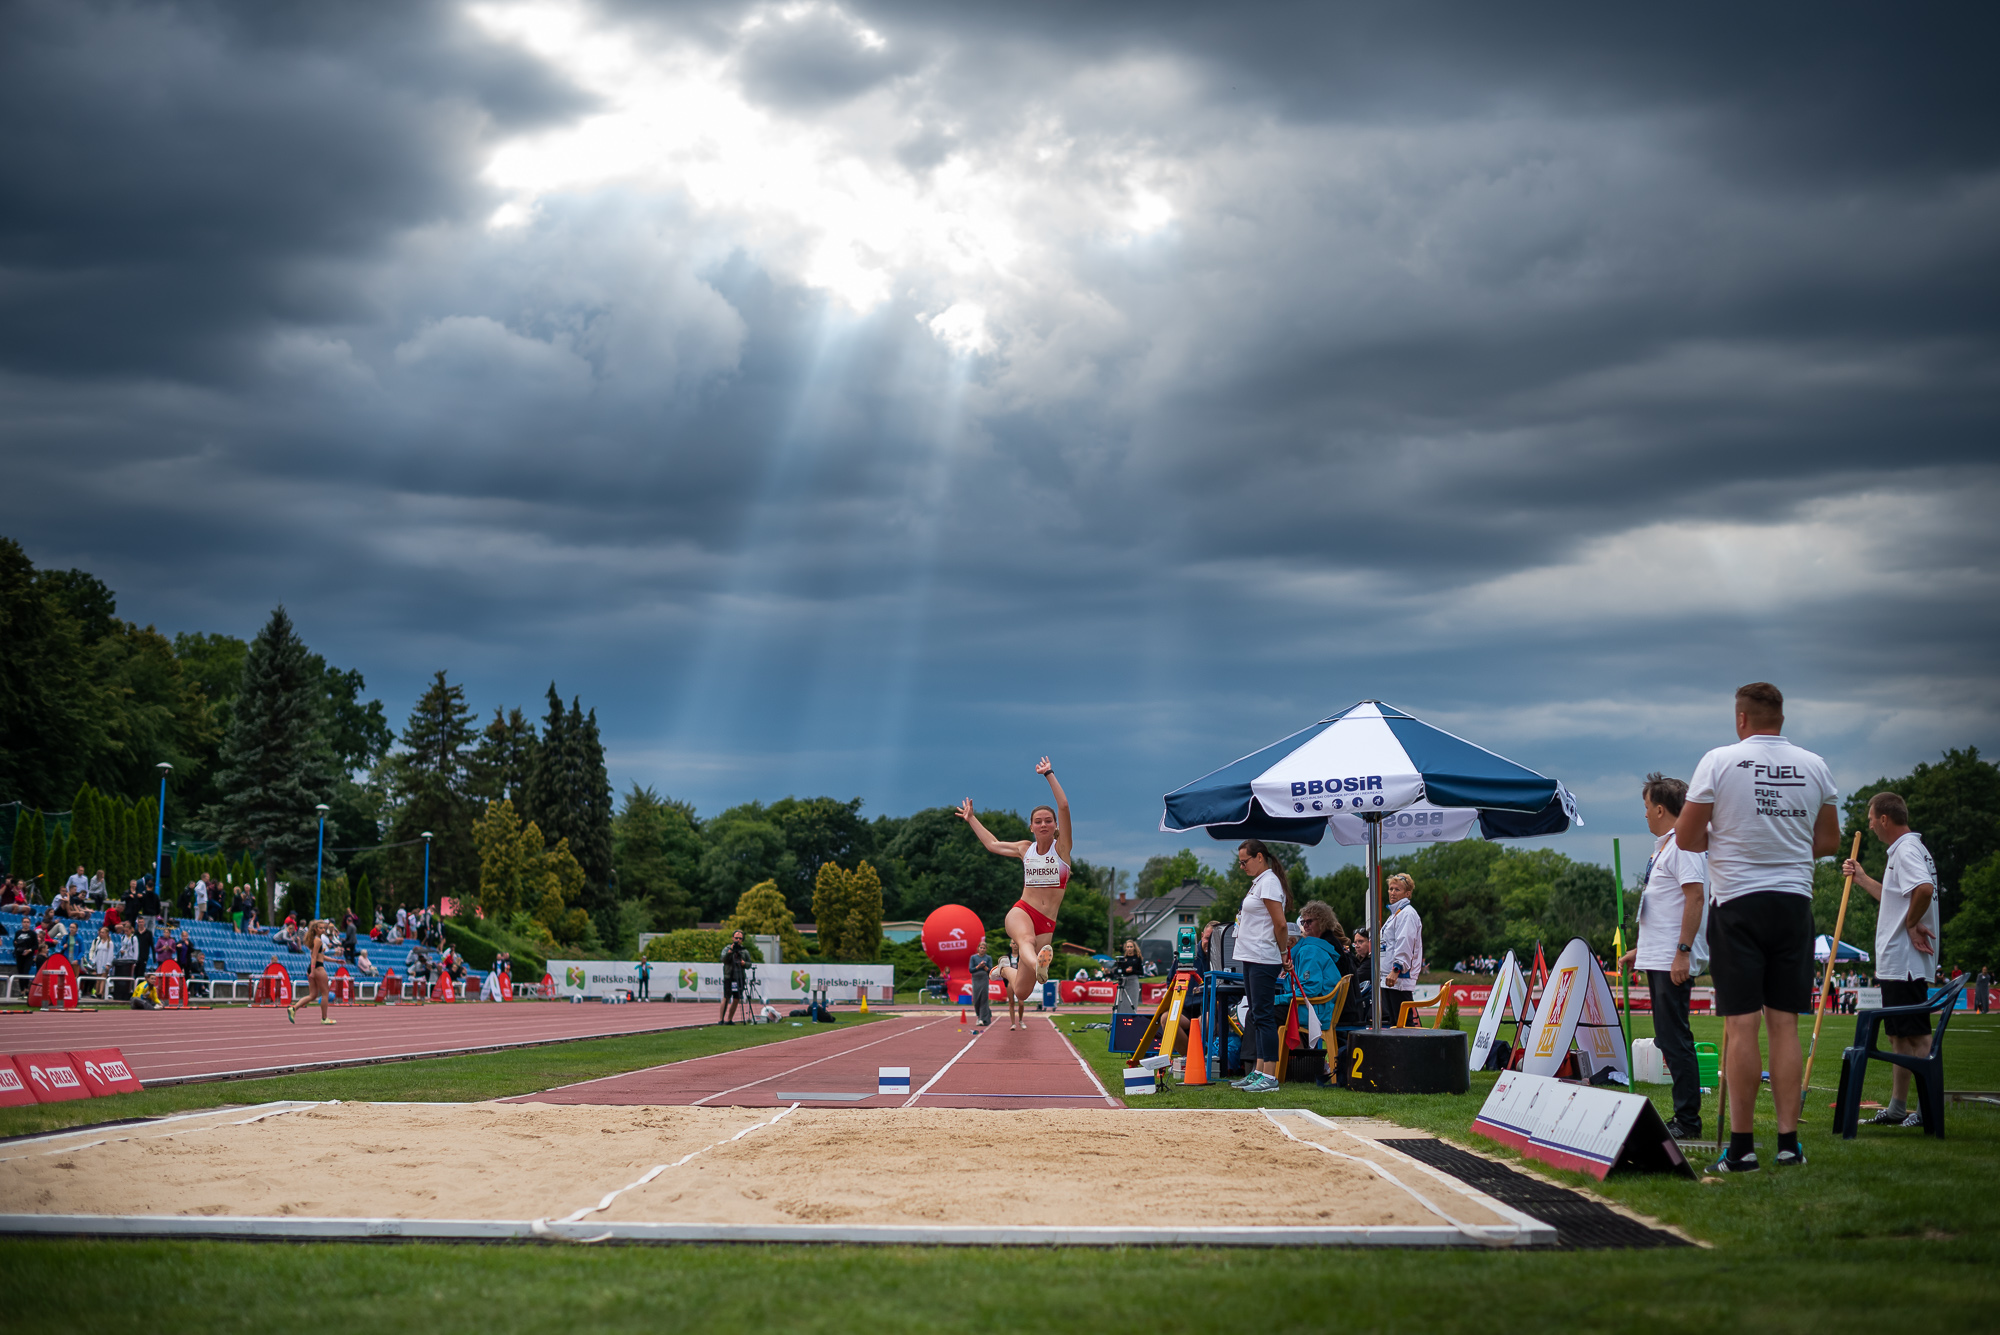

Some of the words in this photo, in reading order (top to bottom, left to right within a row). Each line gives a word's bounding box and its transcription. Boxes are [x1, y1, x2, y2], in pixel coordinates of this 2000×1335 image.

[1736, 760, 1755, 768] 4F
[1755, 765, 1805, 779] FUEL
[1291, 775, 1383, 797] BBOSiR
[1755, 789, 1783, 798] FUEL
[1755, 798, 1777, 807] THE
[1756, 807, 1807, 817] MUSCLES
[1045, 856, 1055, 864] 56
[1025, 868, 1059, 876] PAPIERSKA
[940, 941, 966, 950] ORLEN
[592, 975, 640, 984] Bielsko-Bia
[818, 978, 874, 987] Bielsko-Biała
[1351, 1047, 1364, 1079] 2
[103, 1063, 129, 1079] ORLEN
[0, 1072, 20, 1088] RLEN
[50, 1068, 78, 1085] ORLEN
